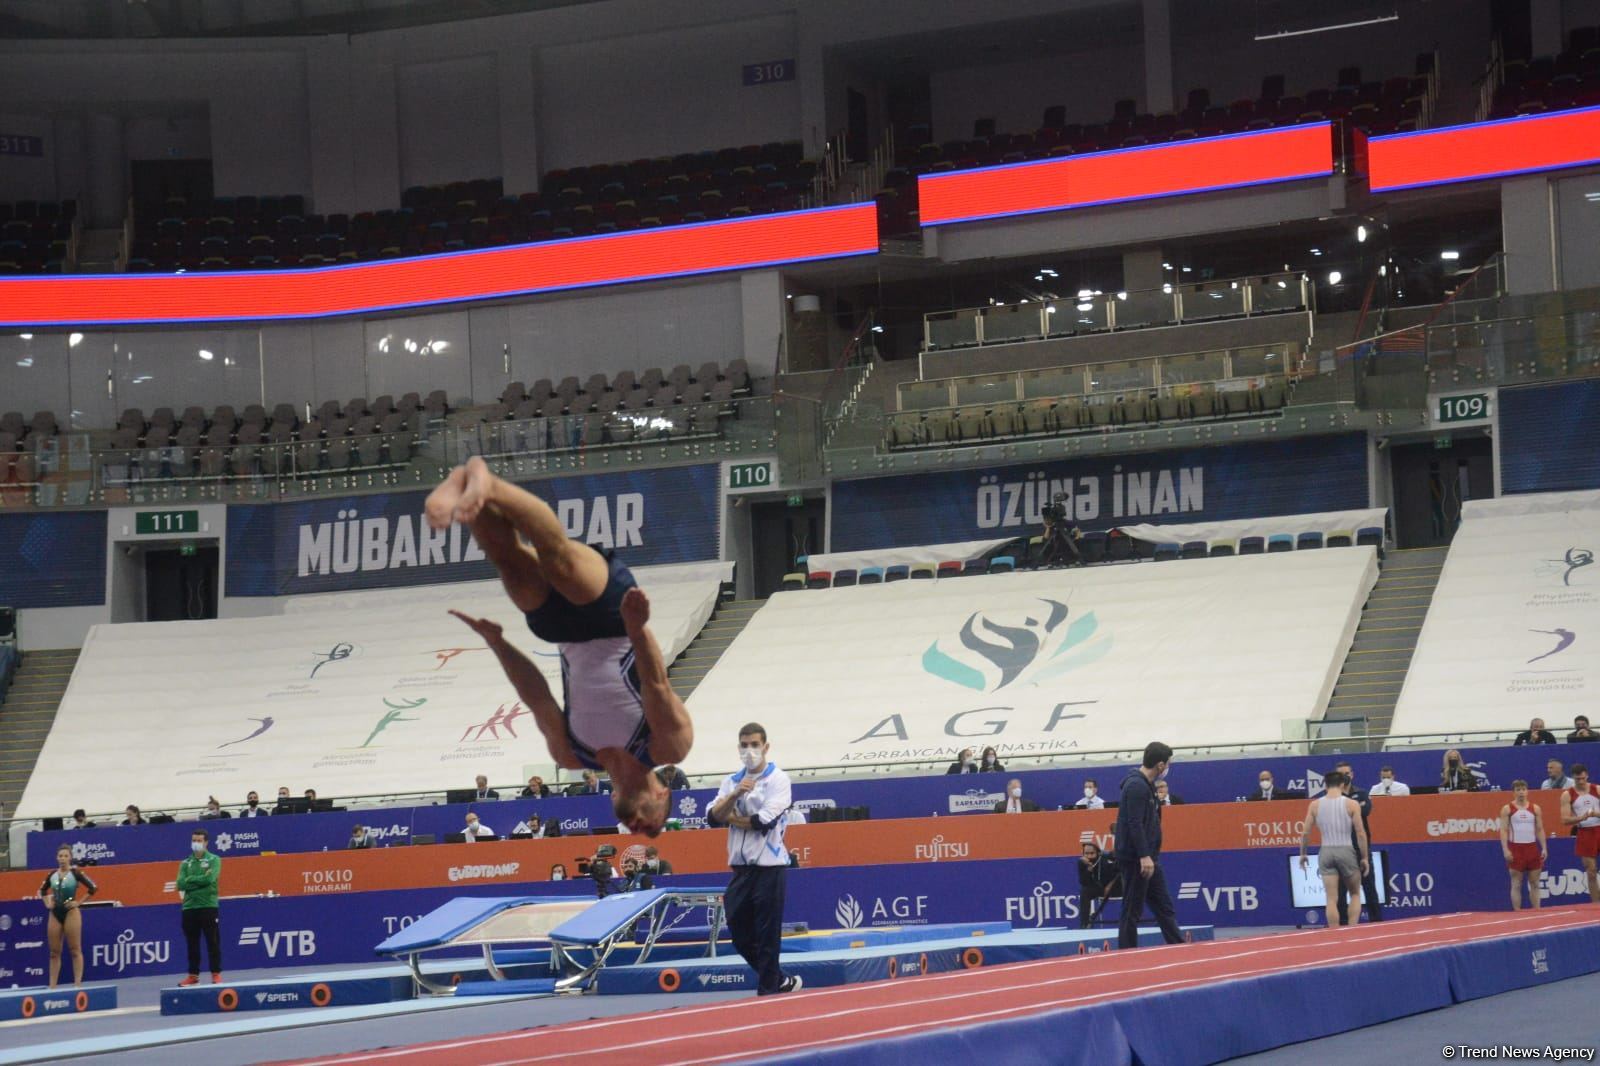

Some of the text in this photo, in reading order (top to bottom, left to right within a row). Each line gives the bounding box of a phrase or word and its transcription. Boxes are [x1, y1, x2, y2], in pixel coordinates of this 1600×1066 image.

[754, 64, 784, 81] 310
[1443, 397, 1483, 418] 109
[733, 466, 767, 485] 110
[1113, 464, 1204, 517] İNAN
[152, 514, 183, 530] 111
[557, 493, 644, 548] PAR
[849, 700, 1099, 743] AGF
[1287, 779, 1306, 790] AZ
[233, 832, 259, 841] PASHA
[1243, 821, 1305, 836] TOKIO
[234, 839, 260, 849] Travel
[915, 835, 969, 862] FUJITSU
[1095, 834, 1116, 851] VT
[1247, 836, 1302, 847] INKARAM
[302, 869, 353, 884] TOKIO
[303, 882, 352, 893] INKARAMI
[871, 896, 928, 918] AGF
[1202, 886, 1259, 911] VTB
[93, 929, 170, 972] FUJITSU
[262, 929, 316, 958] VTB
[711, 973, 745, 984] SPIETH
[267, 992, 299, 1003] SPIETH
